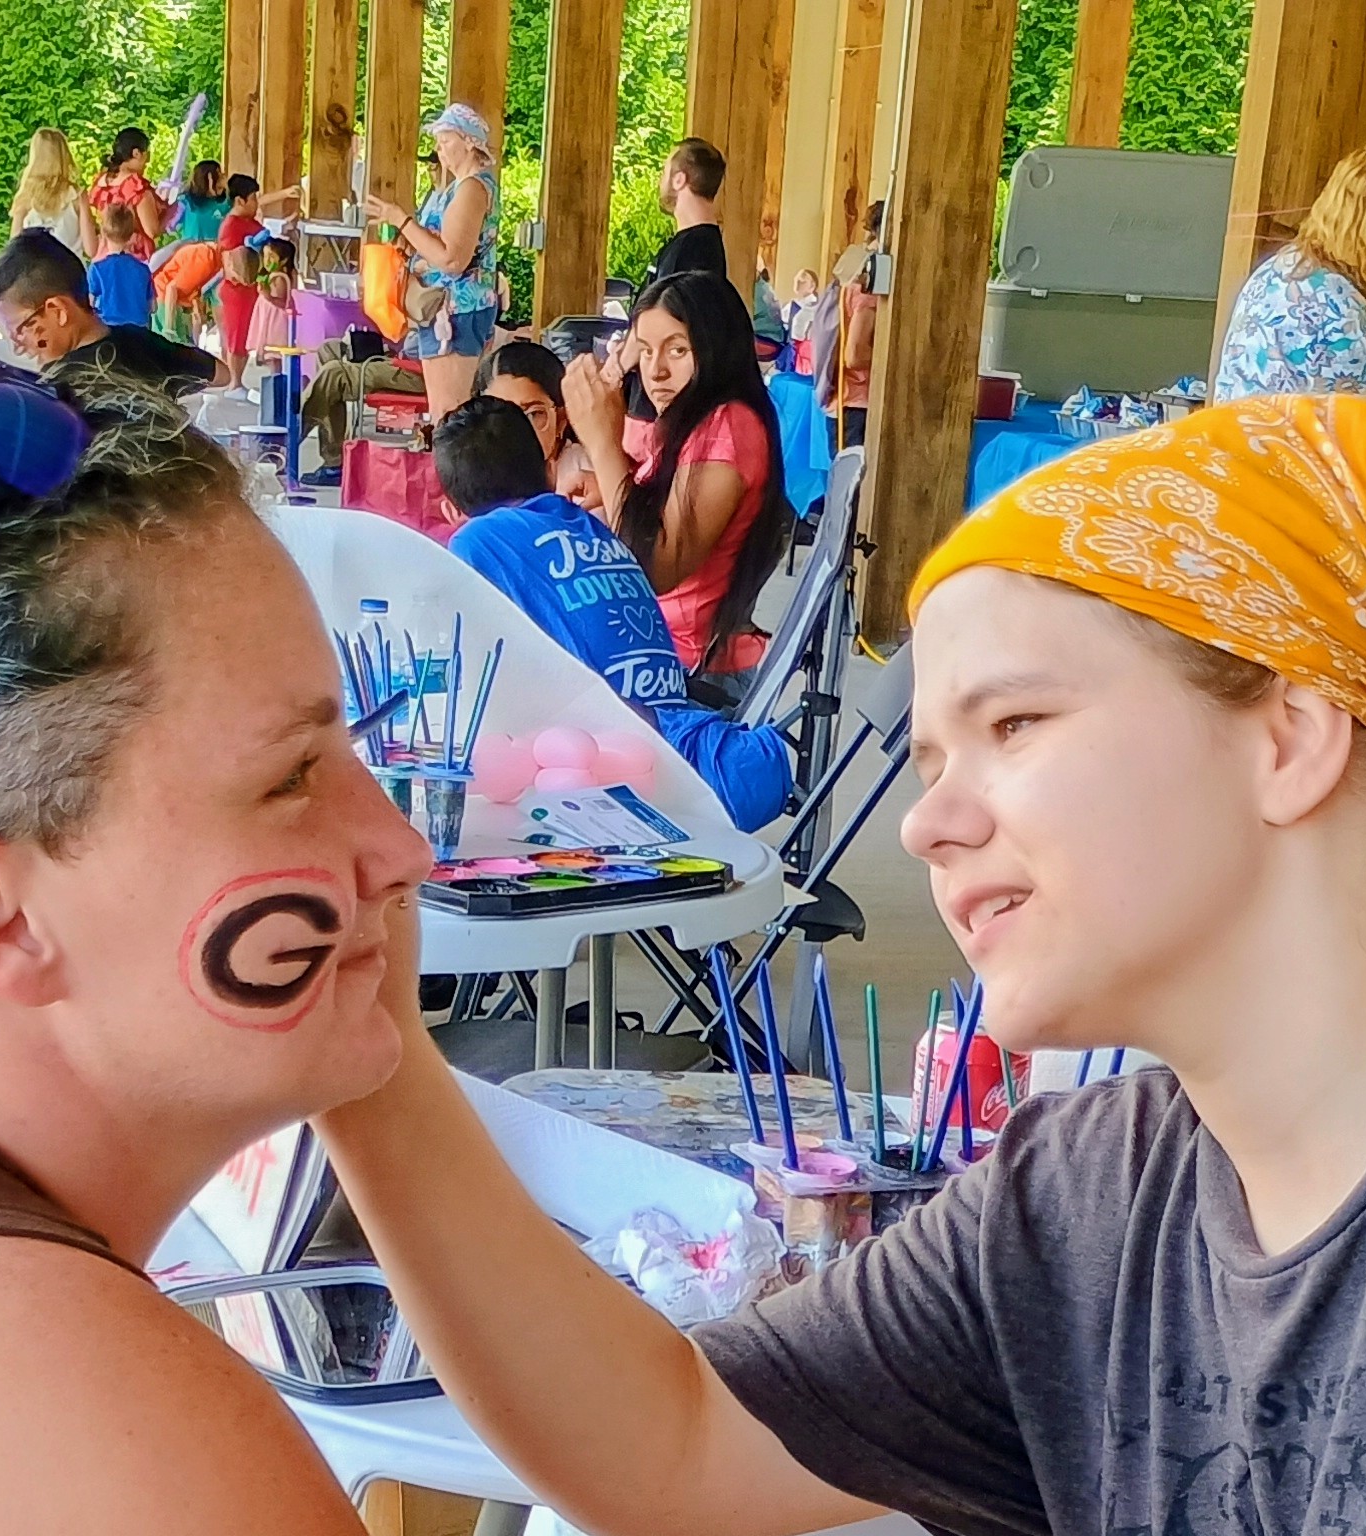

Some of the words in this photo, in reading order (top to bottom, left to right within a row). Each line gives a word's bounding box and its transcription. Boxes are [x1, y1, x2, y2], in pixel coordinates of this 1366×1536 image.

[535, 529, 639, 580] Jesu
[555, 572, 639, 612] LOVES
[201, 892, 342, 1009] G
